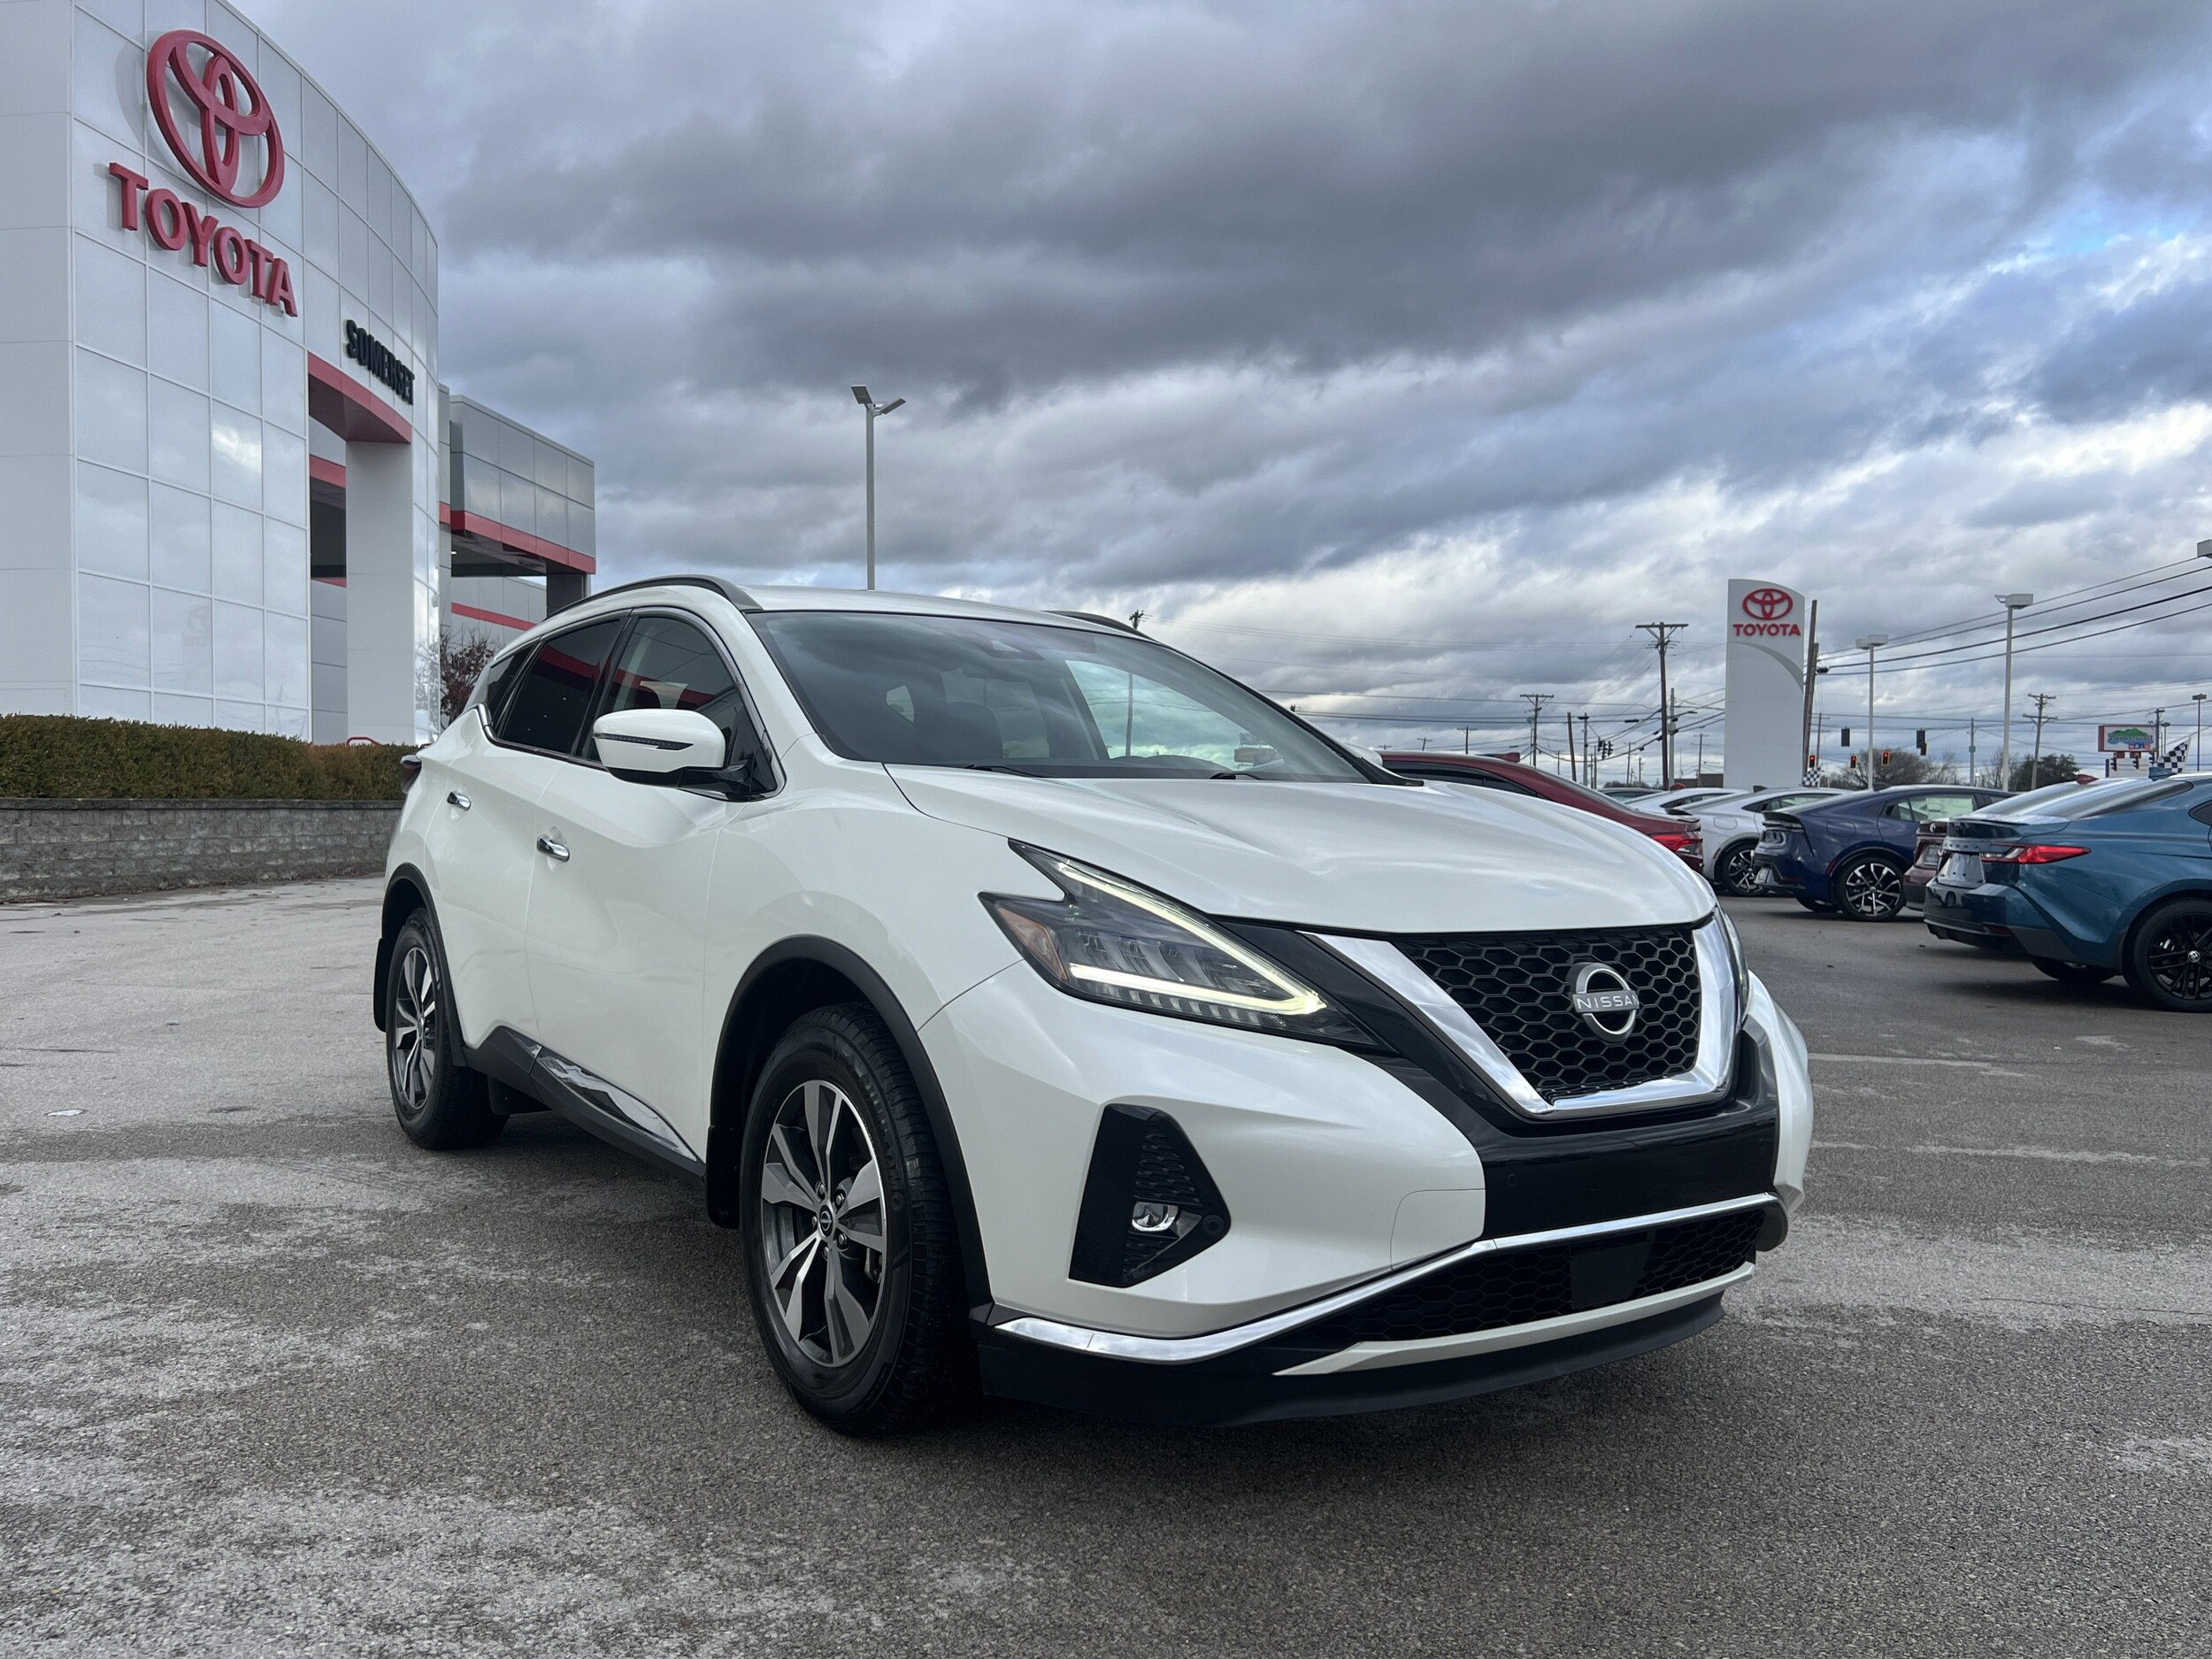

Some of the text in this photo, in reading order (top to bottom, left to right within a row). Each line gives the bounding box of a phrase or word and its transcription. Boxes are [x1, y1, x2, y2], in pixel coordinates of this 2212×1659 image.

[109, 163, 298, 318] TOYOTA
[346, 319, 415, 406] SOMERSET
[1732, 623, 1801, 636] TOYOTA
[1577, 995, 1640, 1010] NISSAN
